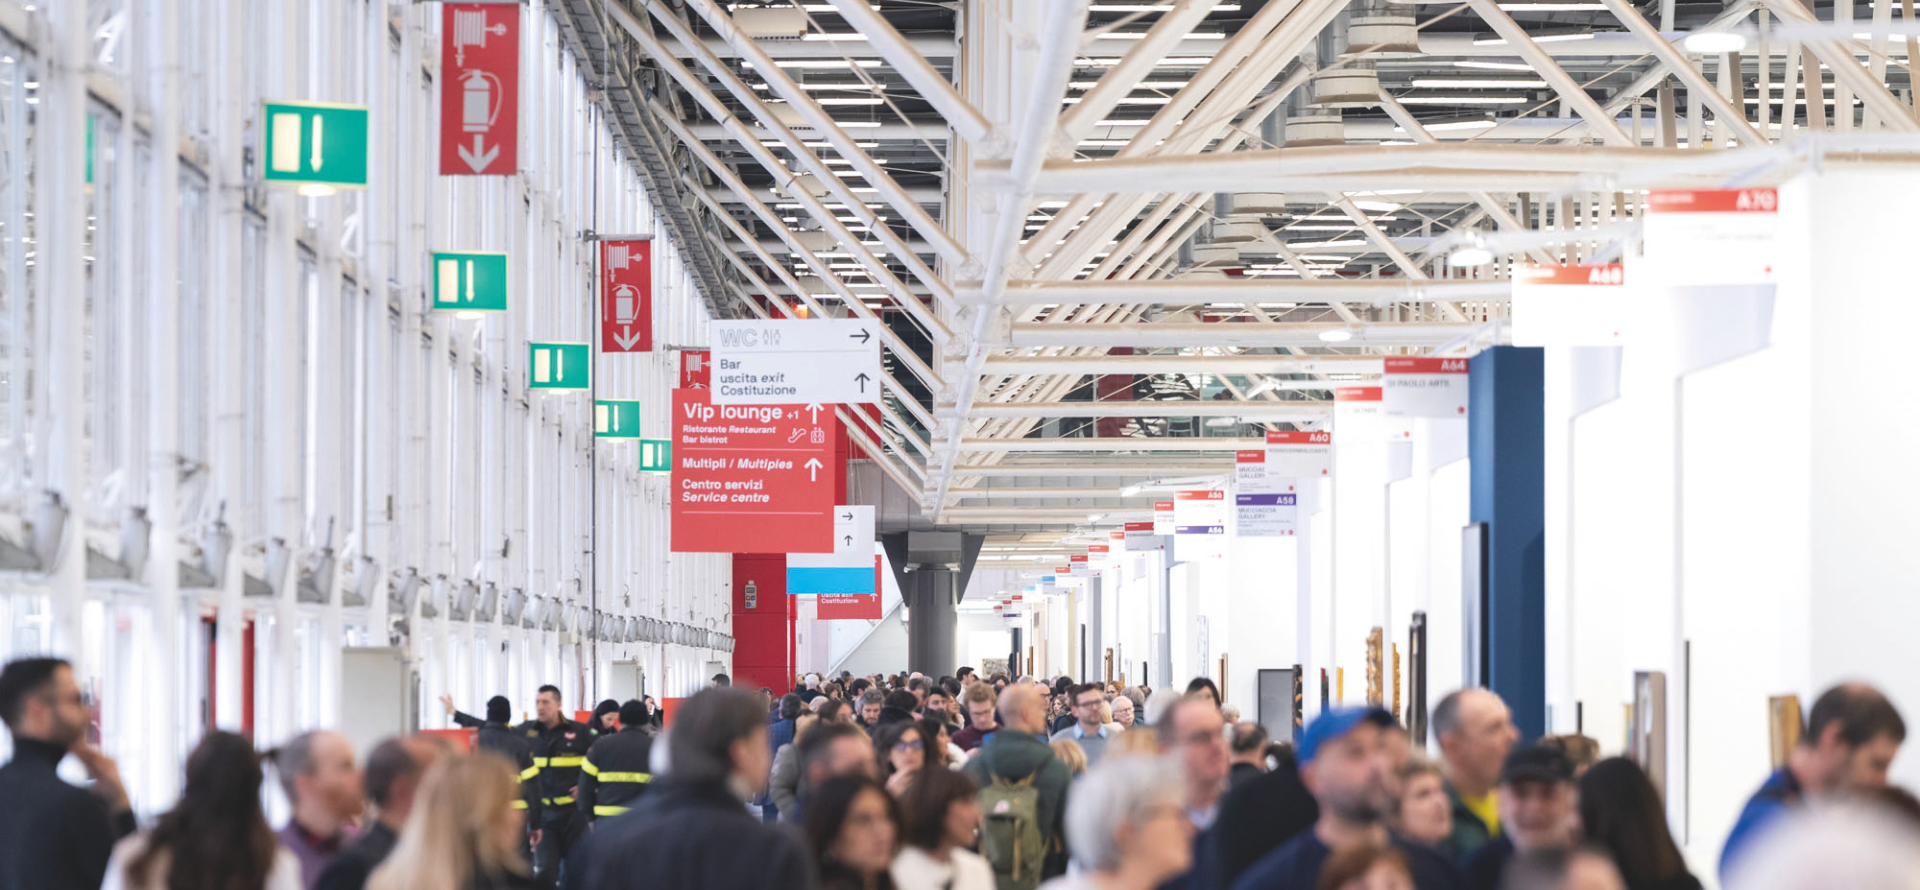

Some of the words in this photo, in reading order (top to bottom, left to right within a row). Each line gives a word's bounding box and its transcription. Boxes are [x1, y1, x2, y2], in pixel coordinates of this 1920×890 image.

[720, 329, 758, 347] WC
[720, 359, 741, 370] Bar
[1440, 359, 1466, 371] A64
[720, 373, 757, 384] uscita
[761, 372, 785, 383] exit
[1397, 379, 1426, 388] PAOLO
[720, 385, 797, 396] Costituzione
[683, 403, 714, 422] Vip
[721, 404, 783, 423] lounge
[786, 411, 800, 420] +1
[682, 425, 727, 434] Ristorante
[728, 425, 777, 434] Restaurant
[682, 435, 698, 444] Bar
[699, 435, 728, 444] bistrot
[1309, 433, 1329, 442] A60
[682, 458, 727, 471] Multipli
[737, 458, 793, 471] Multiples
[682, 479, 722, 490] Centro
[724, 479, 764, 490] servizi
[682, 492, 727, 503] Service
[731, 492, 770, 503] centre
[1276, 496, 1295, 505] A58
